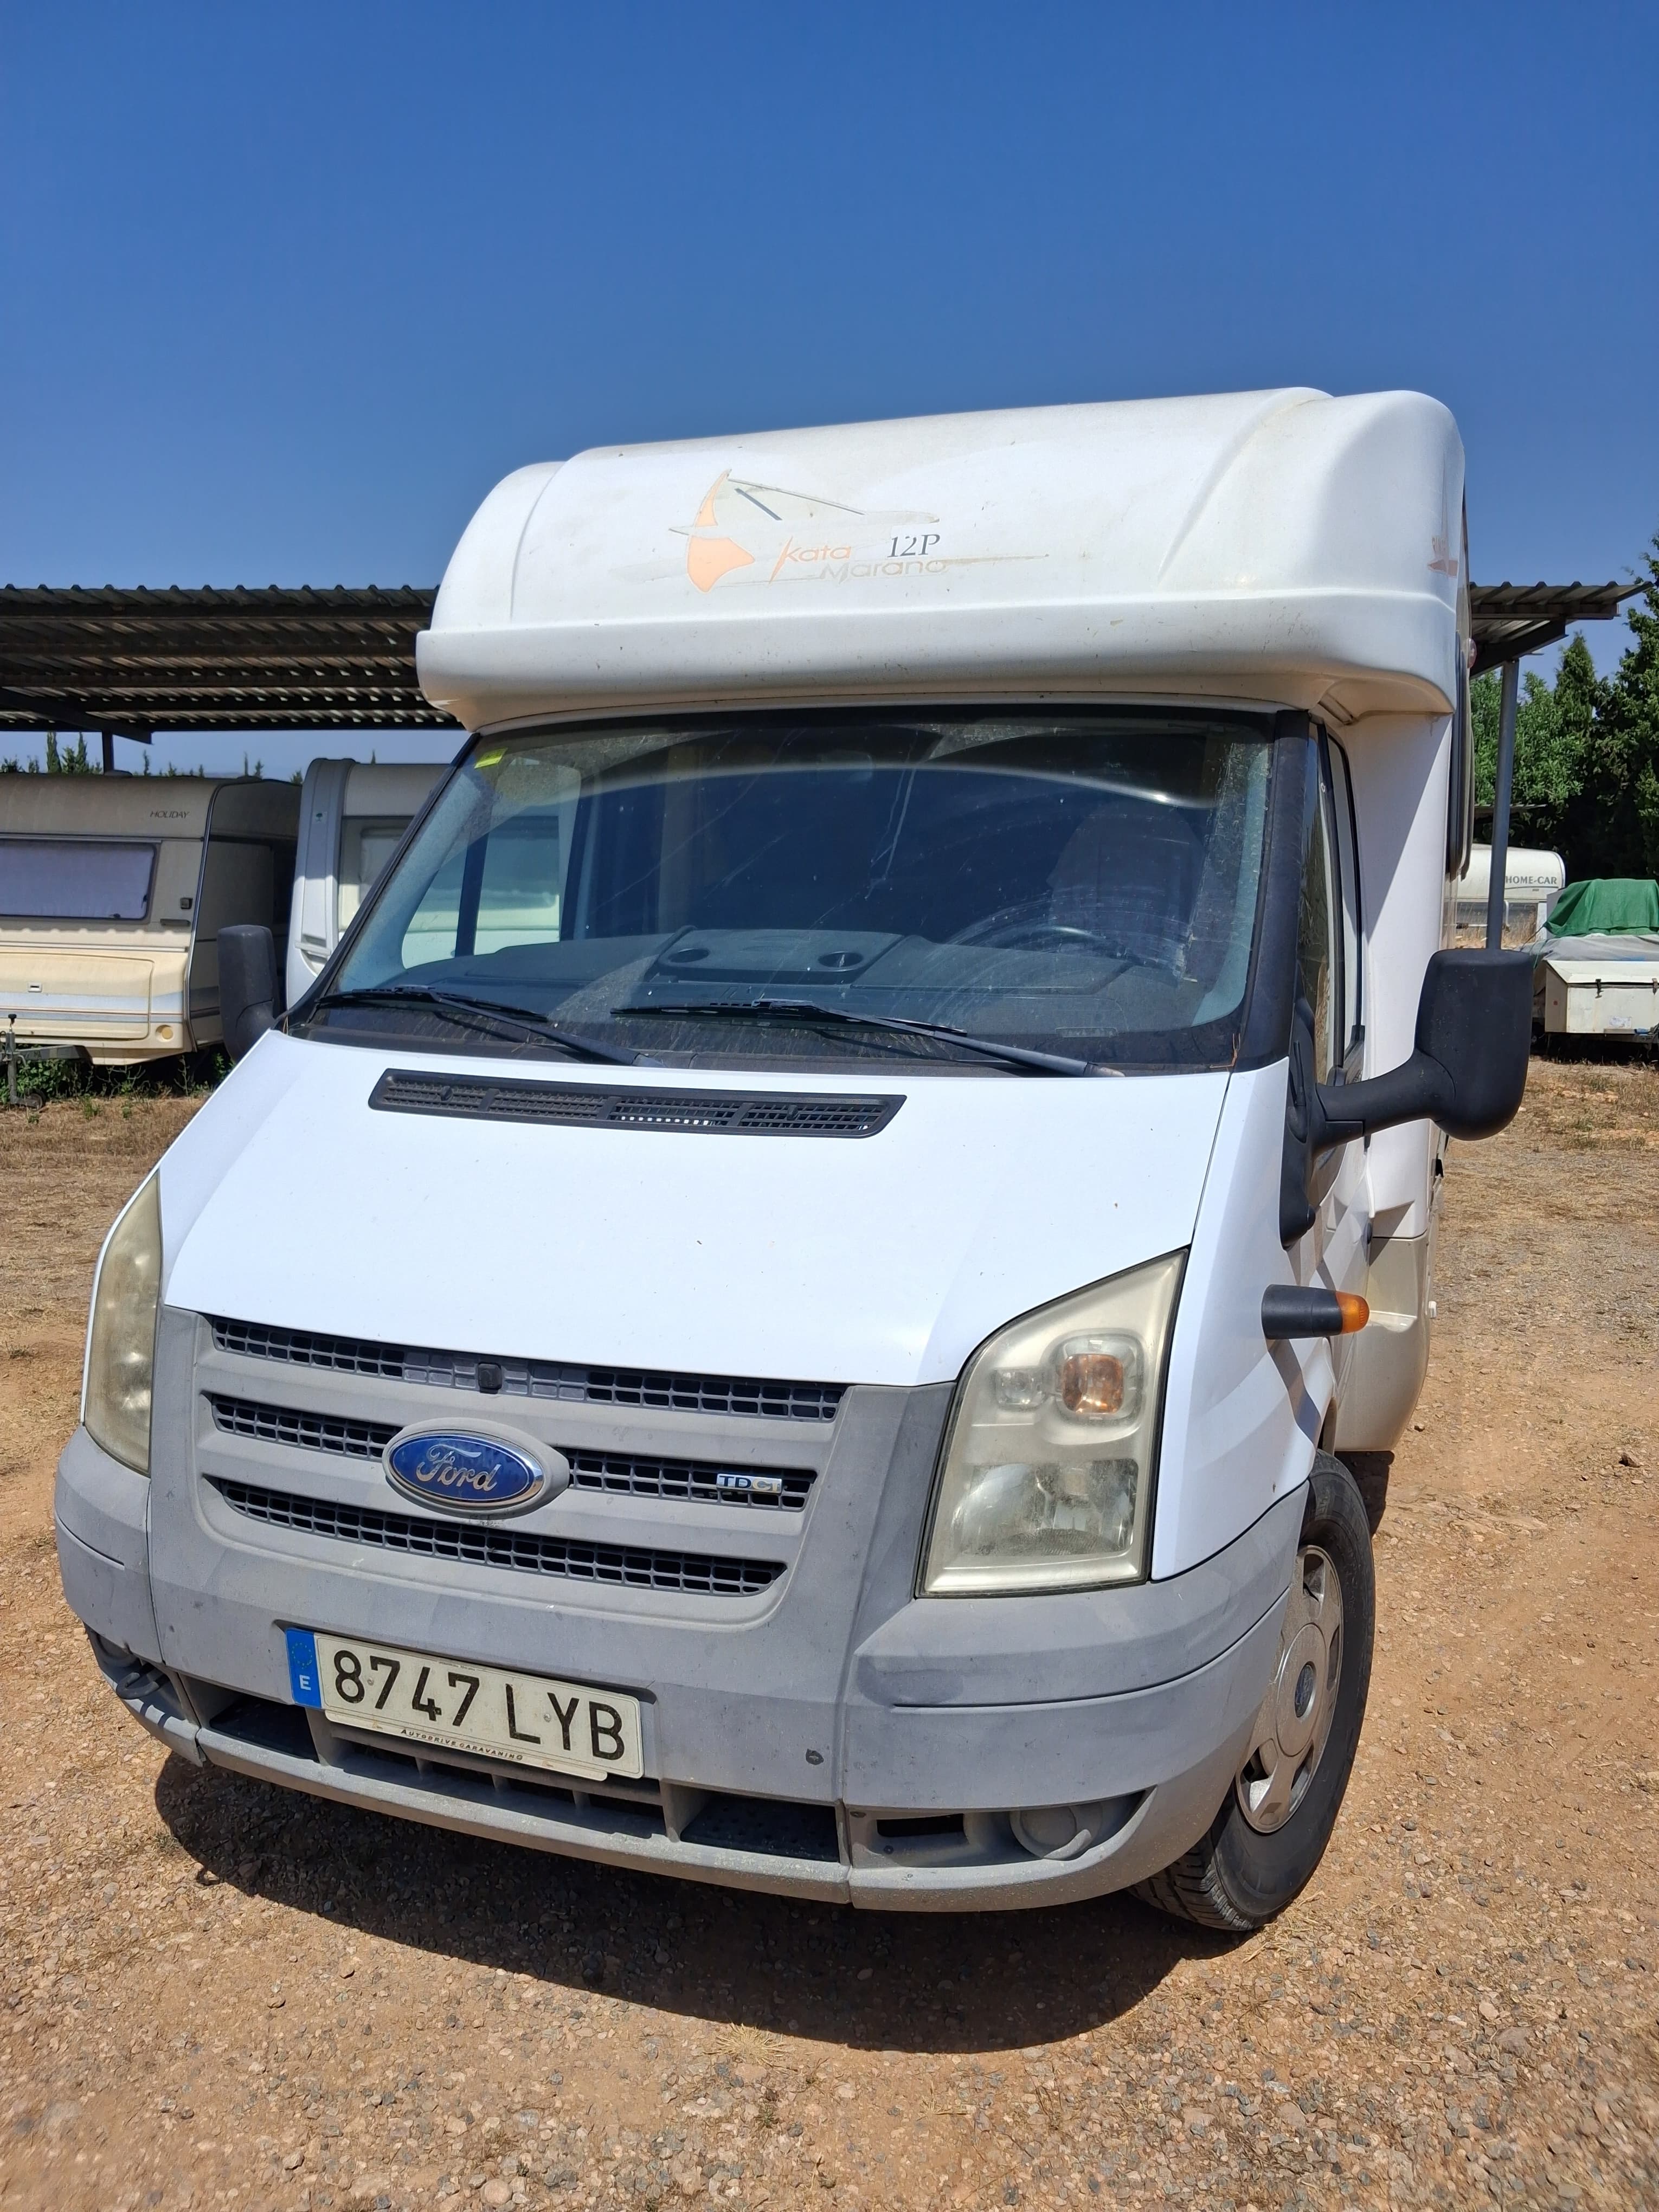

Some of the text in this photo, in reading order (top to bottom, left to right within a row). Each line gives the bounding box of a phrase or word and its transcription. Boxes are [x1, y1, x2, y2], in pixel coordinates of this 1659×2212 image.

[887, 533, 940, 558] 12P
[150, 811, 190, 819] HOLIDAY
[1505, 876, 1557, 885] HOME-CAR
[416, 1444, 501, 1491] Ford
[299, 1674, 312, 1690] E
[333, 1650, 625, 1760] 8747 LYB
[459, 1742, 523, 1760] CARAVANING
